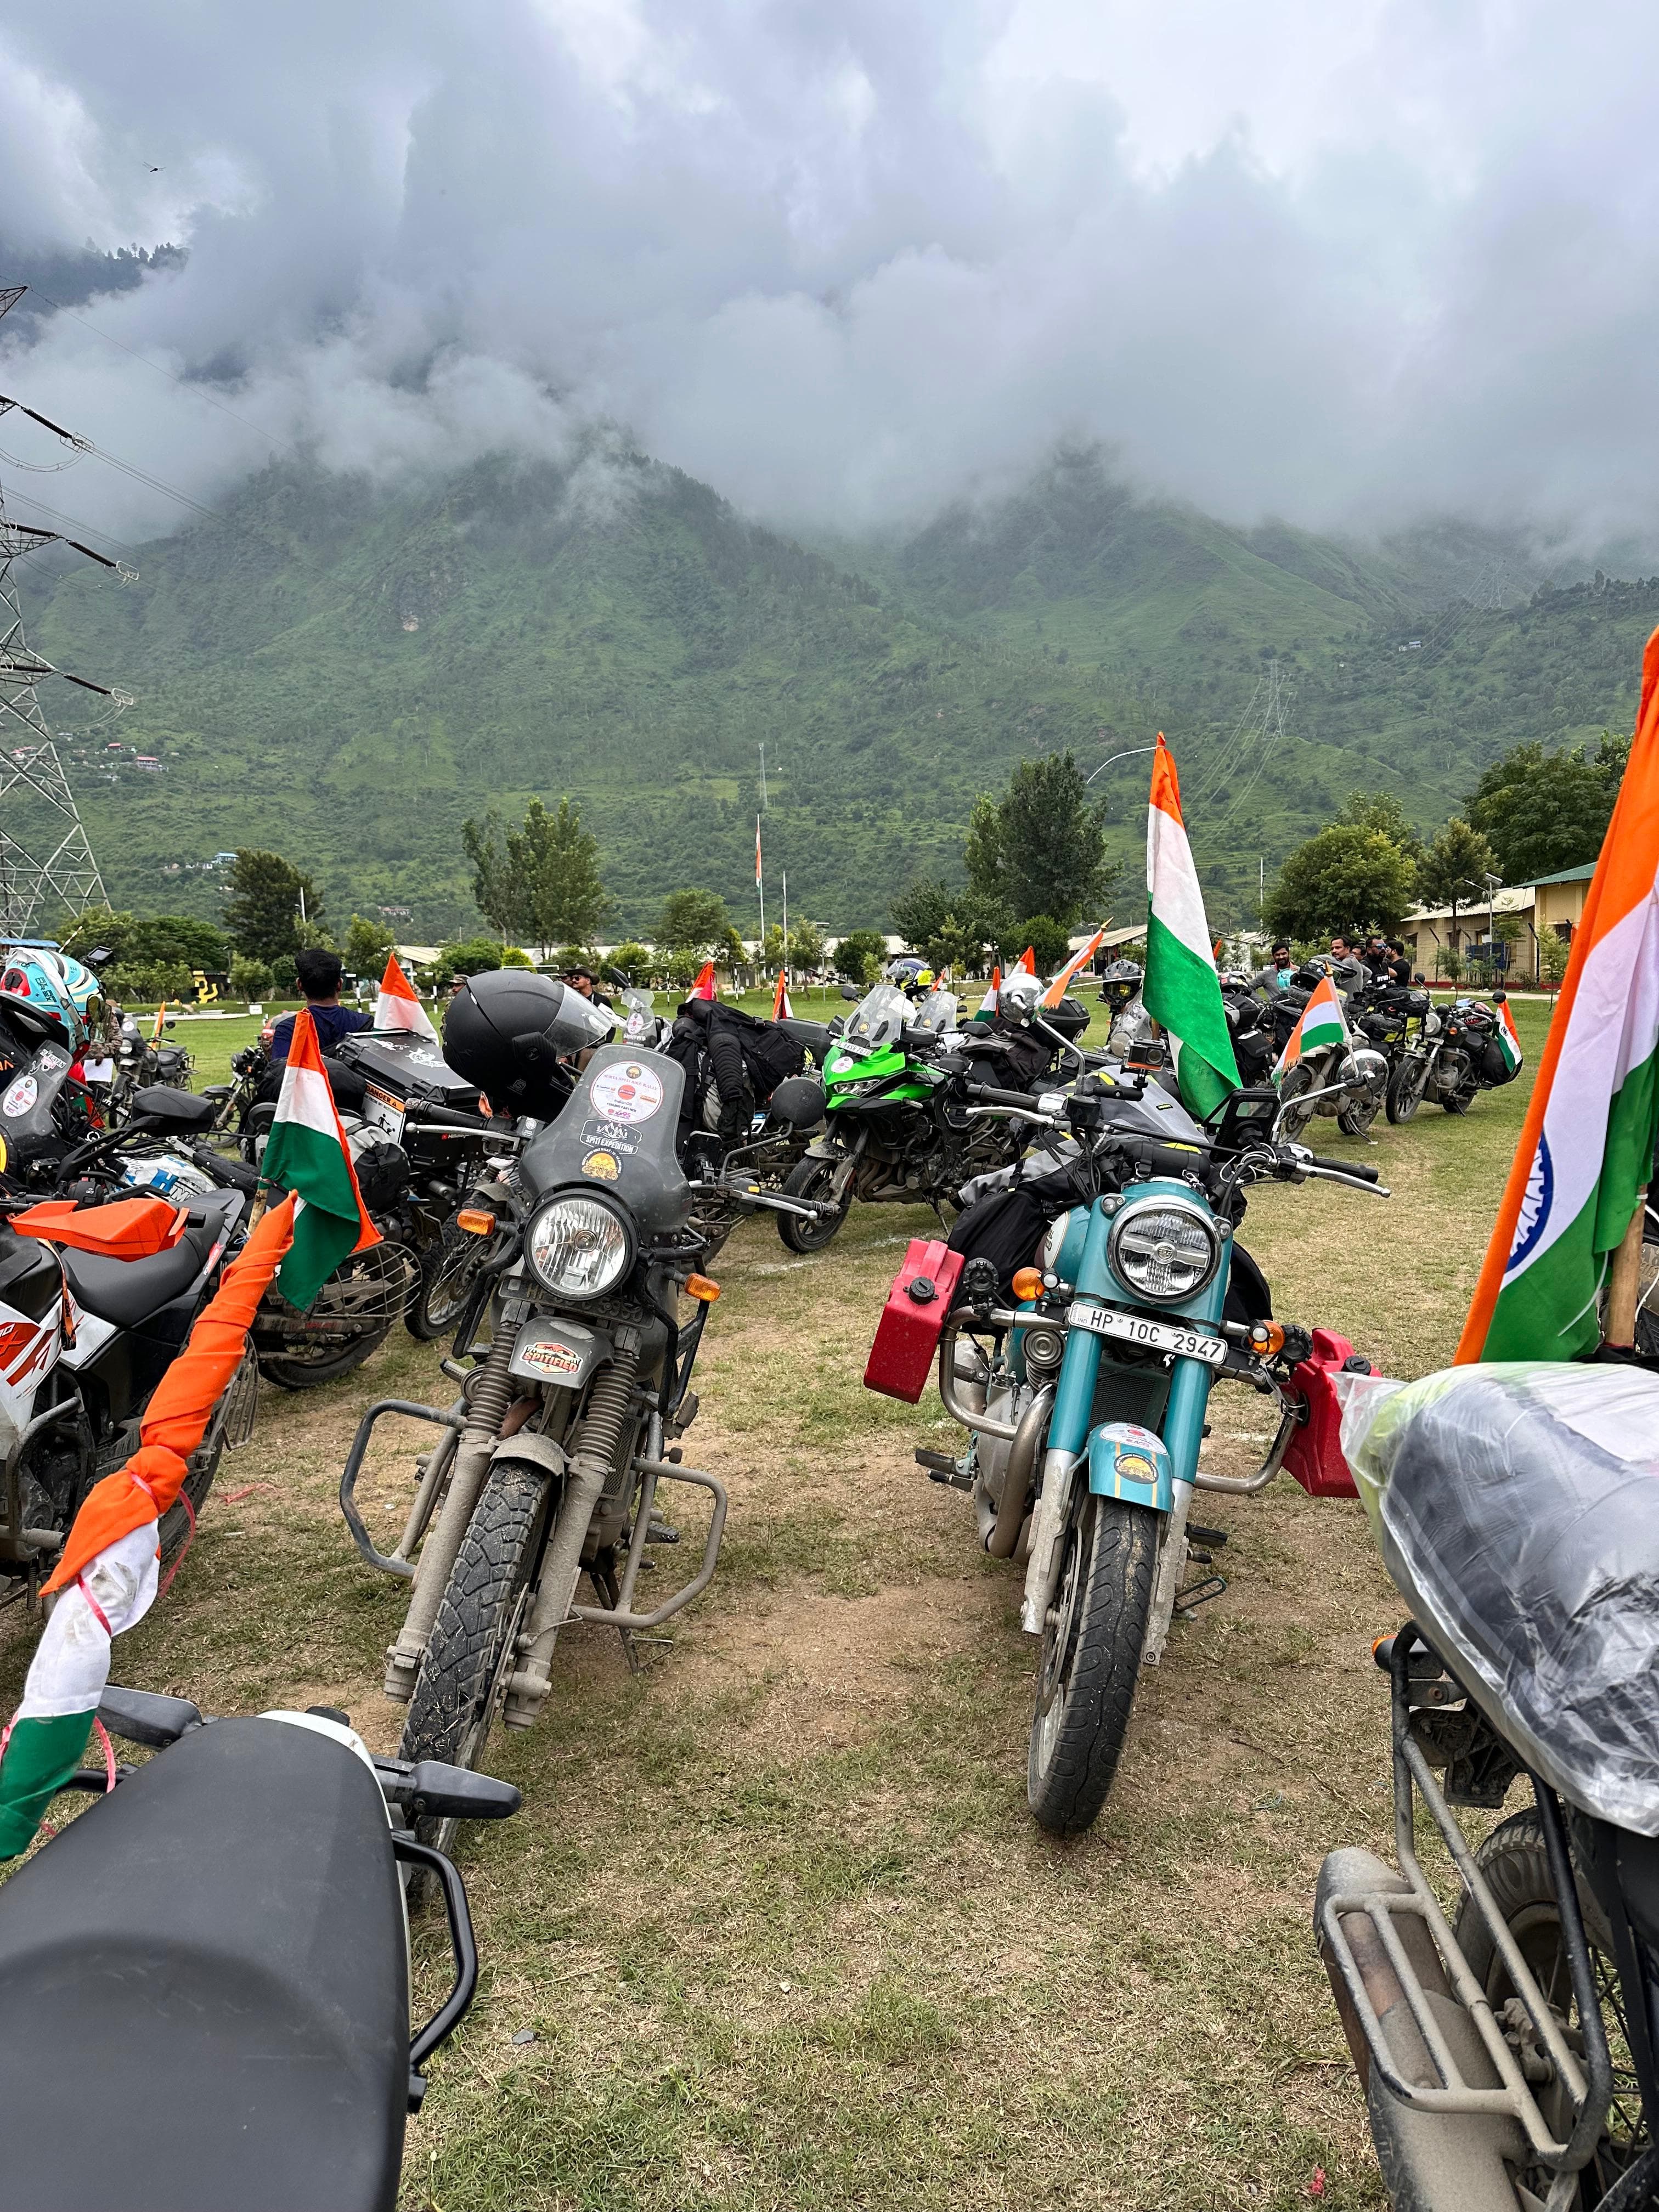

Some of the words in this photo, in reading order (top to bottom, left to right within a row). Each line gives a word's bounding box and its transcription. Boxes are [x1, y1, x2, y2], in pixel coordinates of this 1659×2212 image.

[365, 1085, 391, 1104] DANGER
[585, 1136, 601, 1145] SPITI
[600, 1137, 634, 1153] EXPEDITION
[1090, 1310, 1113, 1329] HP
[1128, 1321, 1160, 1343] 10C
[1173, 1333, 1222, 1358] 2947
[523, 1351, 578, 1372] SPITIFIED
